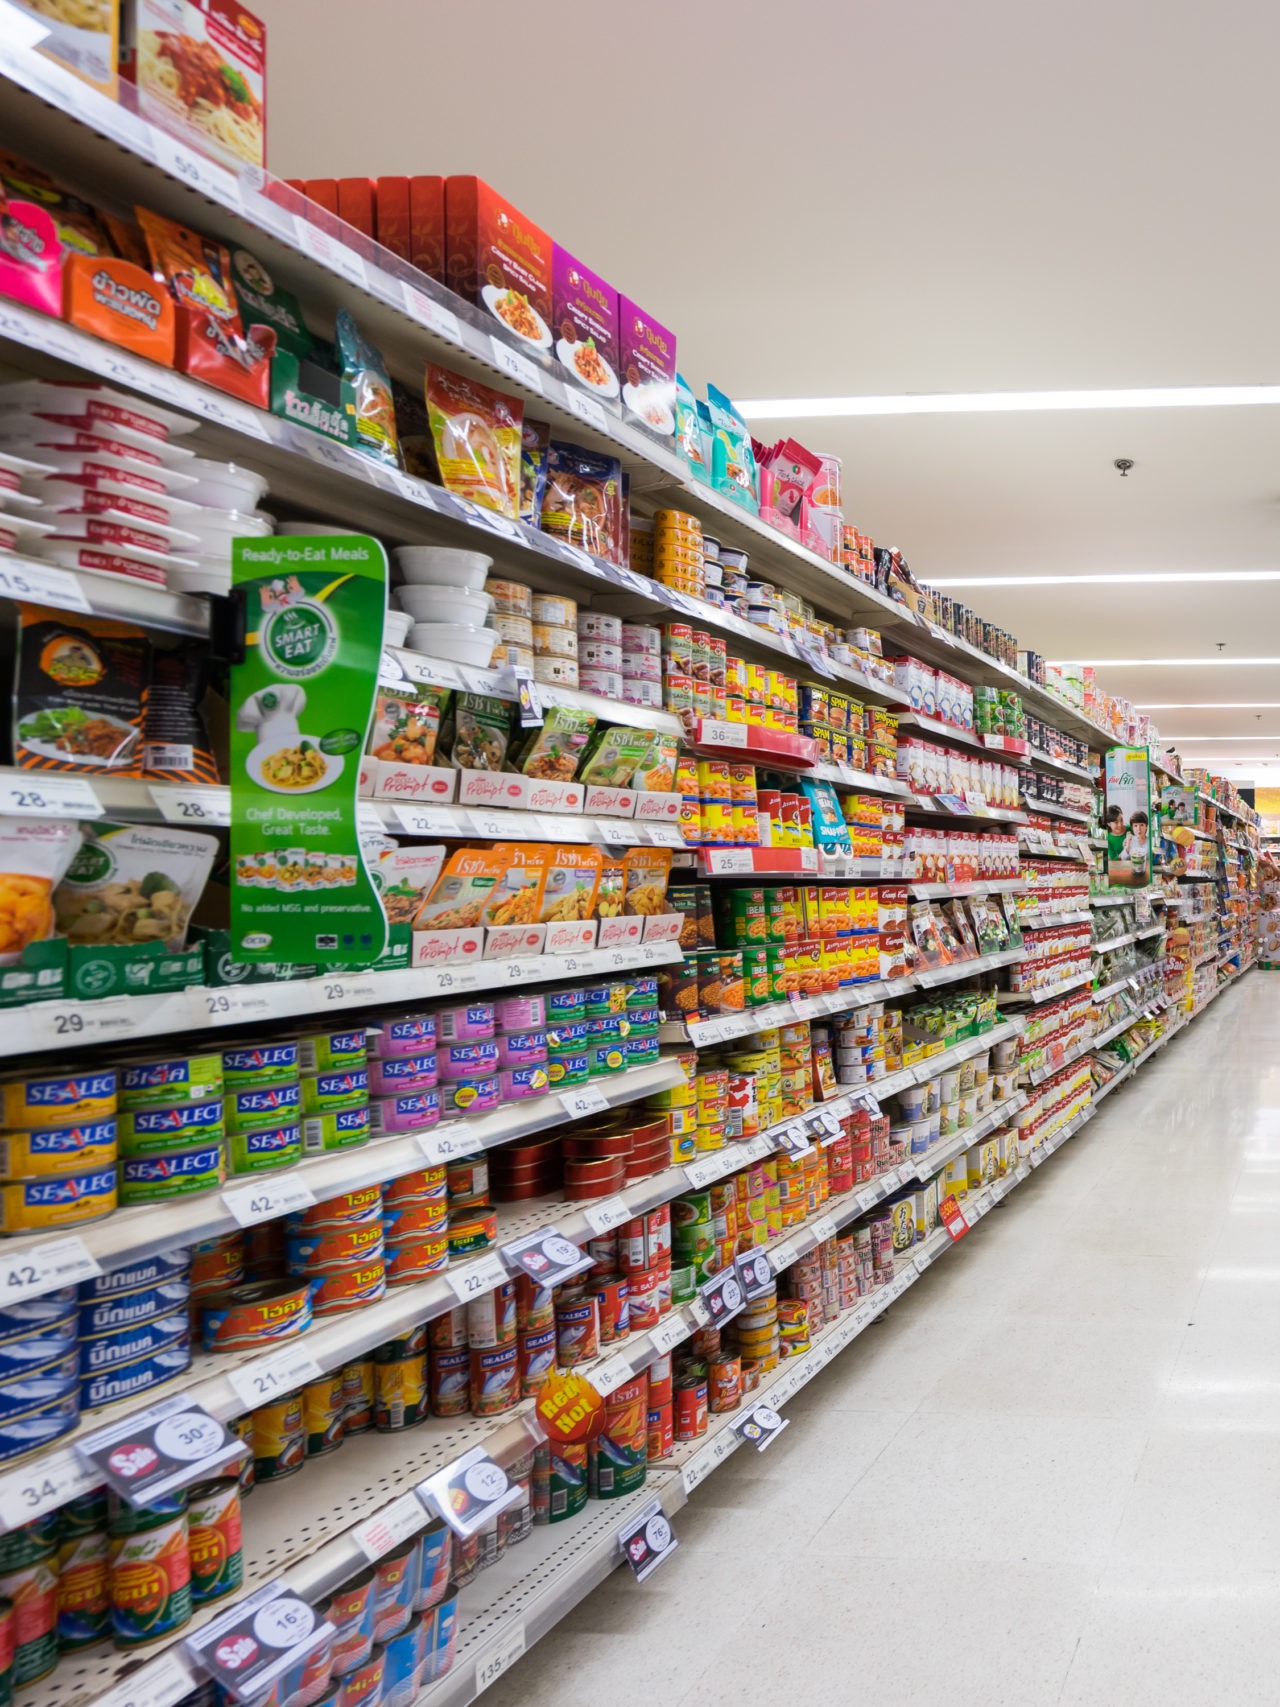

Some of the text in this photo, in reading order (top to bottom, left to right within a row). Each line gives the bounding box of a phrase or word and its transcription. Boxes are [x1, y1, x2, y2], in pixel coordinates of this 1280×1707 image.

[242, 546, 370, 564] Ready-to-Eat Meals
[274, 623, 322, 648] SMART
[284, 639, 313, 659] EAT
[415, 664, 435, 679] 22
[830, 696, 847, 709] SPAM
[851, 703, 864, 715] SPAM
[711, 729, 726, 741] 36
[812, 727, 830, 739] SPAM
[382, 774, 430, 796] Prompt
[11, 788, 47, 808] 28
[177, 801, 205, 817] 28
[246, 807, 343, 823] Chef Developed,
[261, 823, 332, 836] Great Taste.
[720, 858, 733, 870] 25
[241, 903, 372, 915] No added MSG and preservative.
[489, 930, 526, 951] Prompt
[419, 938, 460, 961] Prompt
[508, 964, 522, 978] 29
[565, 958, 577, 970] 29
[1168, 957, 1186, 971] Sale
[437, 973, 453, 987] 29
[324, 984, 344, 1000] 29
[206, 997, 230, 1014] 29
[55, 1014, 84, 1034] 29
[224, 1044, 298, 1071] SEALECT
[575, 1098, 588, 1110] 42
[135, 1103, 223, 1135] SEALECT
[437, 1139, 455, 1155] 42
[125, 1147, 219, 1181] SEALECT
[249, 1196, 274, 1213] 42
[598, 1212, 612, 1226] 16
[8, 1266, 39, 1289] 42
[466, 1274, 482, 1292] 22
[661, 1332, 673, 1346] 17
[254, 1372, 279, 1394] 21
[598, 1371, 612, 1386] 16
[538, 1379, 580, 1420] Red
[554, 1396, 595, 1434] Hot
[713, 1443, 724, 1458] 18
[111, 1444, 159, 1478] Sale
[480, 1472, 497, 1489] 12
[686, 1468, 698, 1485] 22
[22, 1479, 57, 1507] 34
[652, 1526, 664, 1541] 76
[276, 1611, 299, 1631] 16
[216, 1634, 259, 1668] Sale
[479, 1658, 501, 1685] 135
